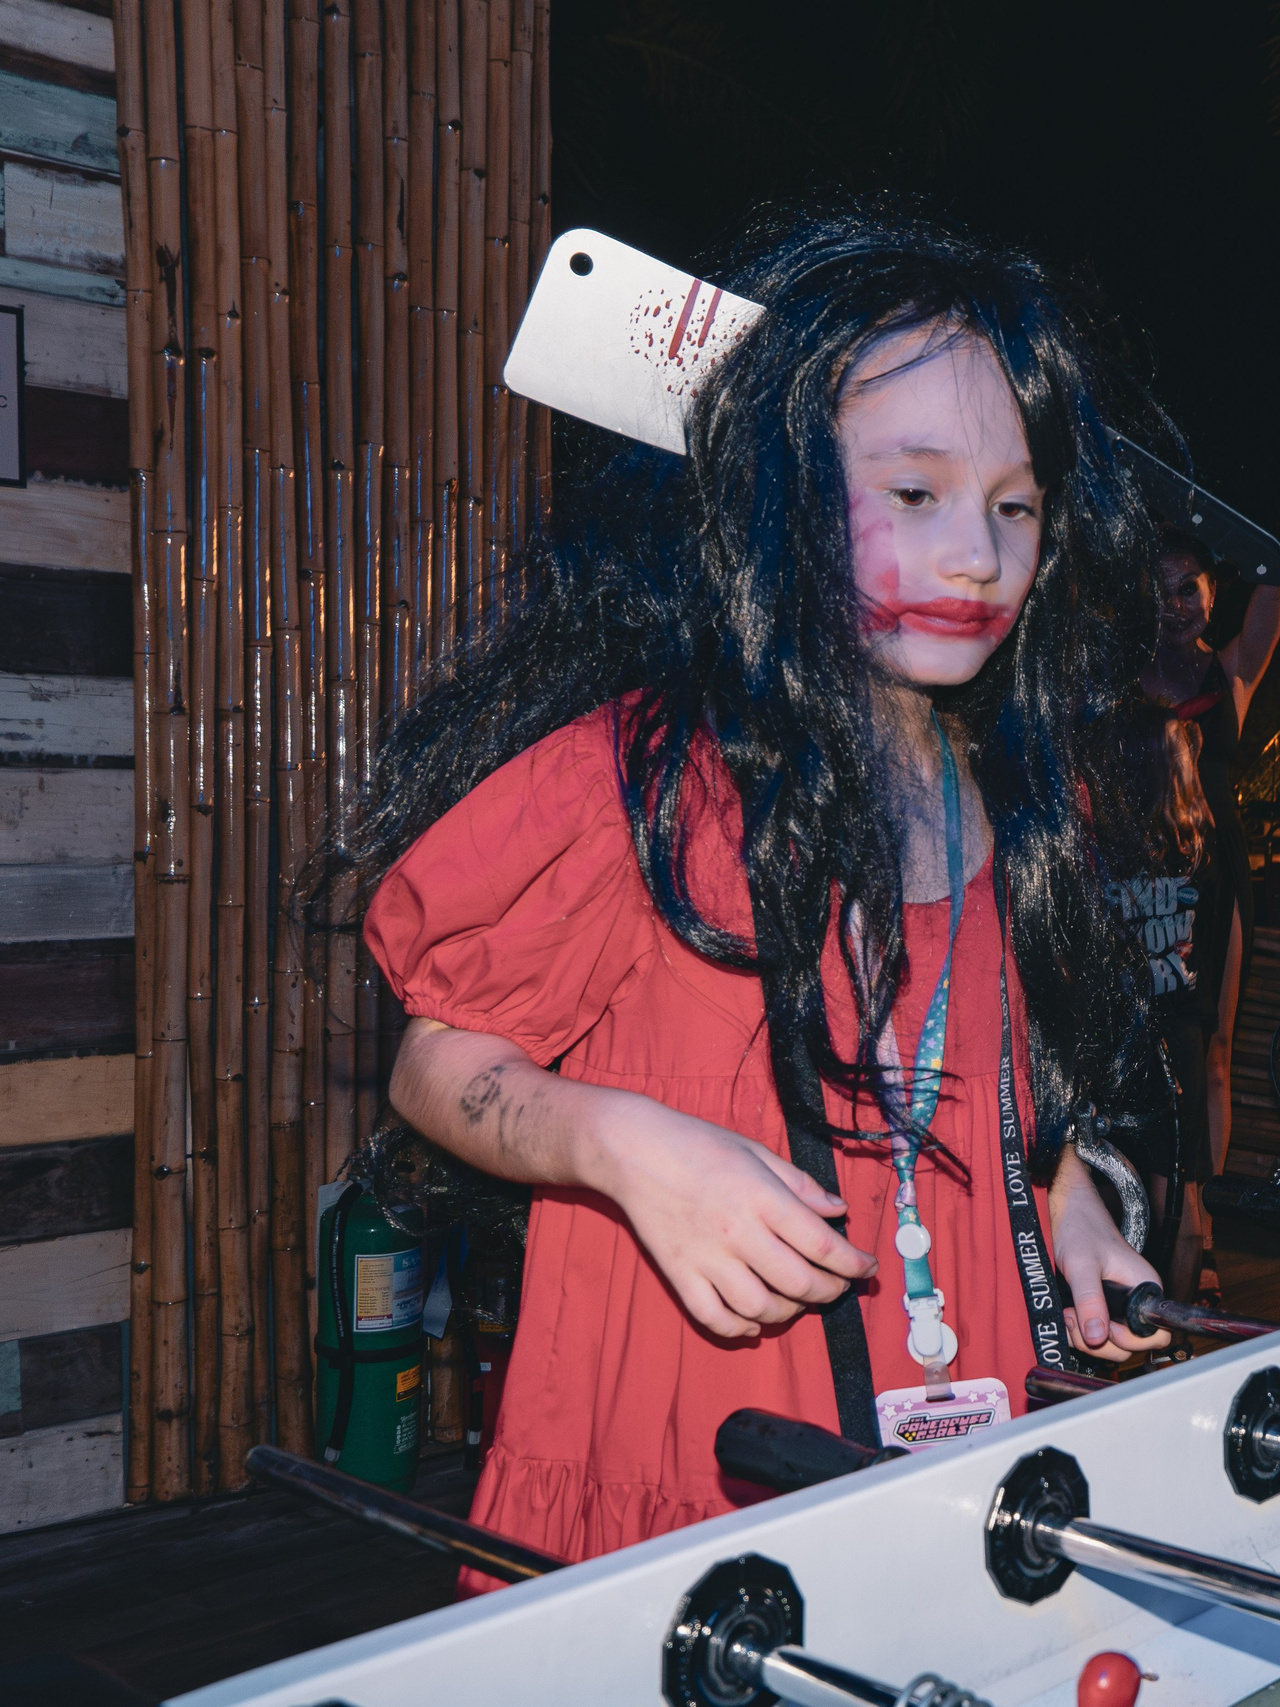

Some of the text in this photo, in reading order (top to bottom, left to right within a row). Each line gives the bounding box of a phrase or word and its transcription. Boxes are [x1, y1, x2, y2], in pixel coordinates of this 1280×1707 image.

[1000, 1055, 1017, 1139] SUMMER
[1006, 1151, 1029, 1207] LOVE
[1018, 1230, 1053, 1310] SUMMER
[898, 1413, 990, 1434] POWERPUFF
[915, 1425, 968, 1441] GIRLS
